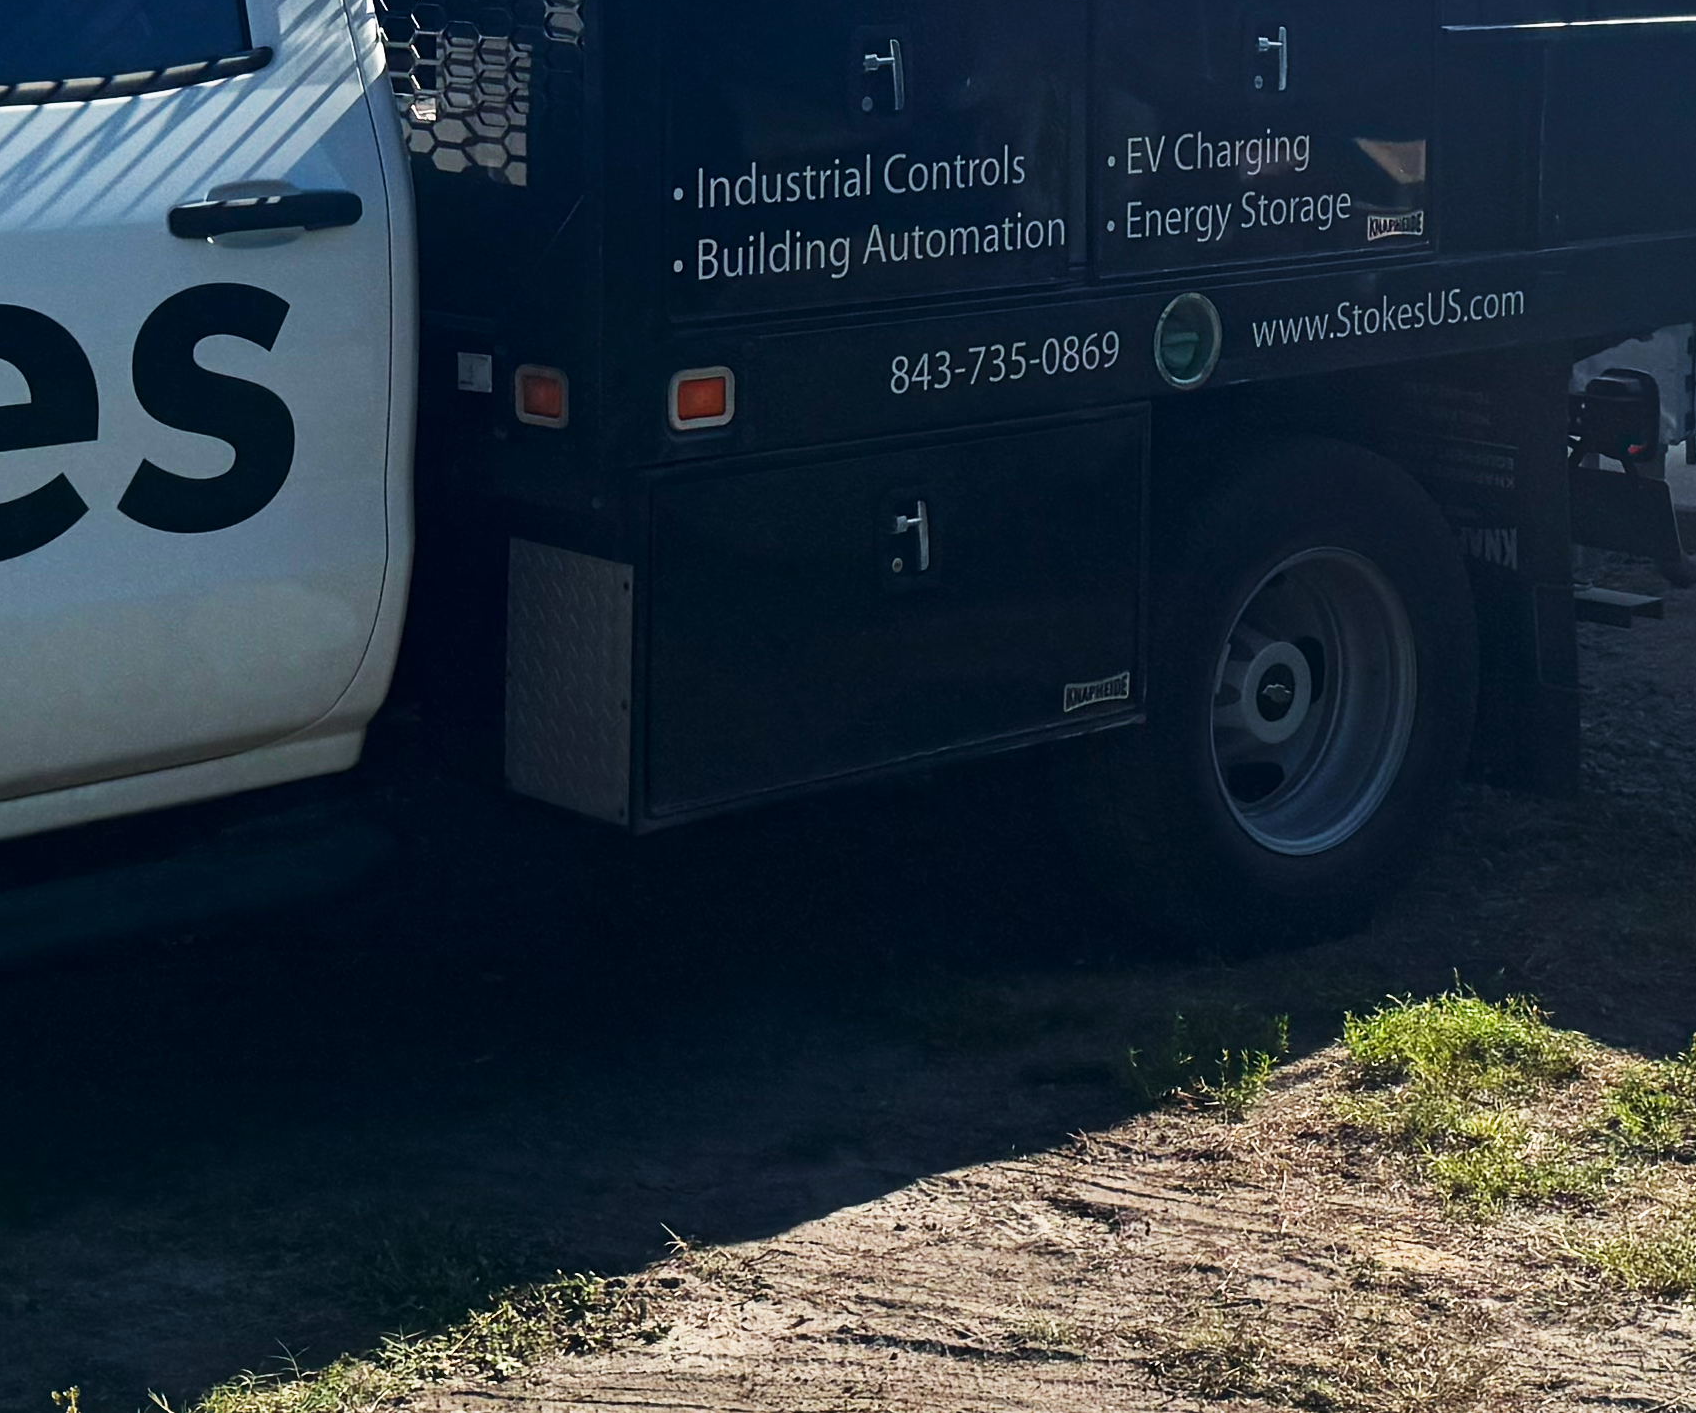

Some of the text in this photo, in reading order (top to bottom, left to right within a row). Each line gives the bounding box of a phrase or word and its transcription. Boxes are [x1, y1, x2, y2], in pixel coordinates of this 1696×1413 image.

[698, 144, 1026, 209] Industrial Controls
[1127, 128, 1311, 175] EV Charging
[698, 211, 1066, 279] Building Automation
[1127, 191, 1352, 242] Energy Storage
[1251, 286, 1526, 349] www.StokesUS.com
[889, 330, 1121, 394] 843-735-0869
